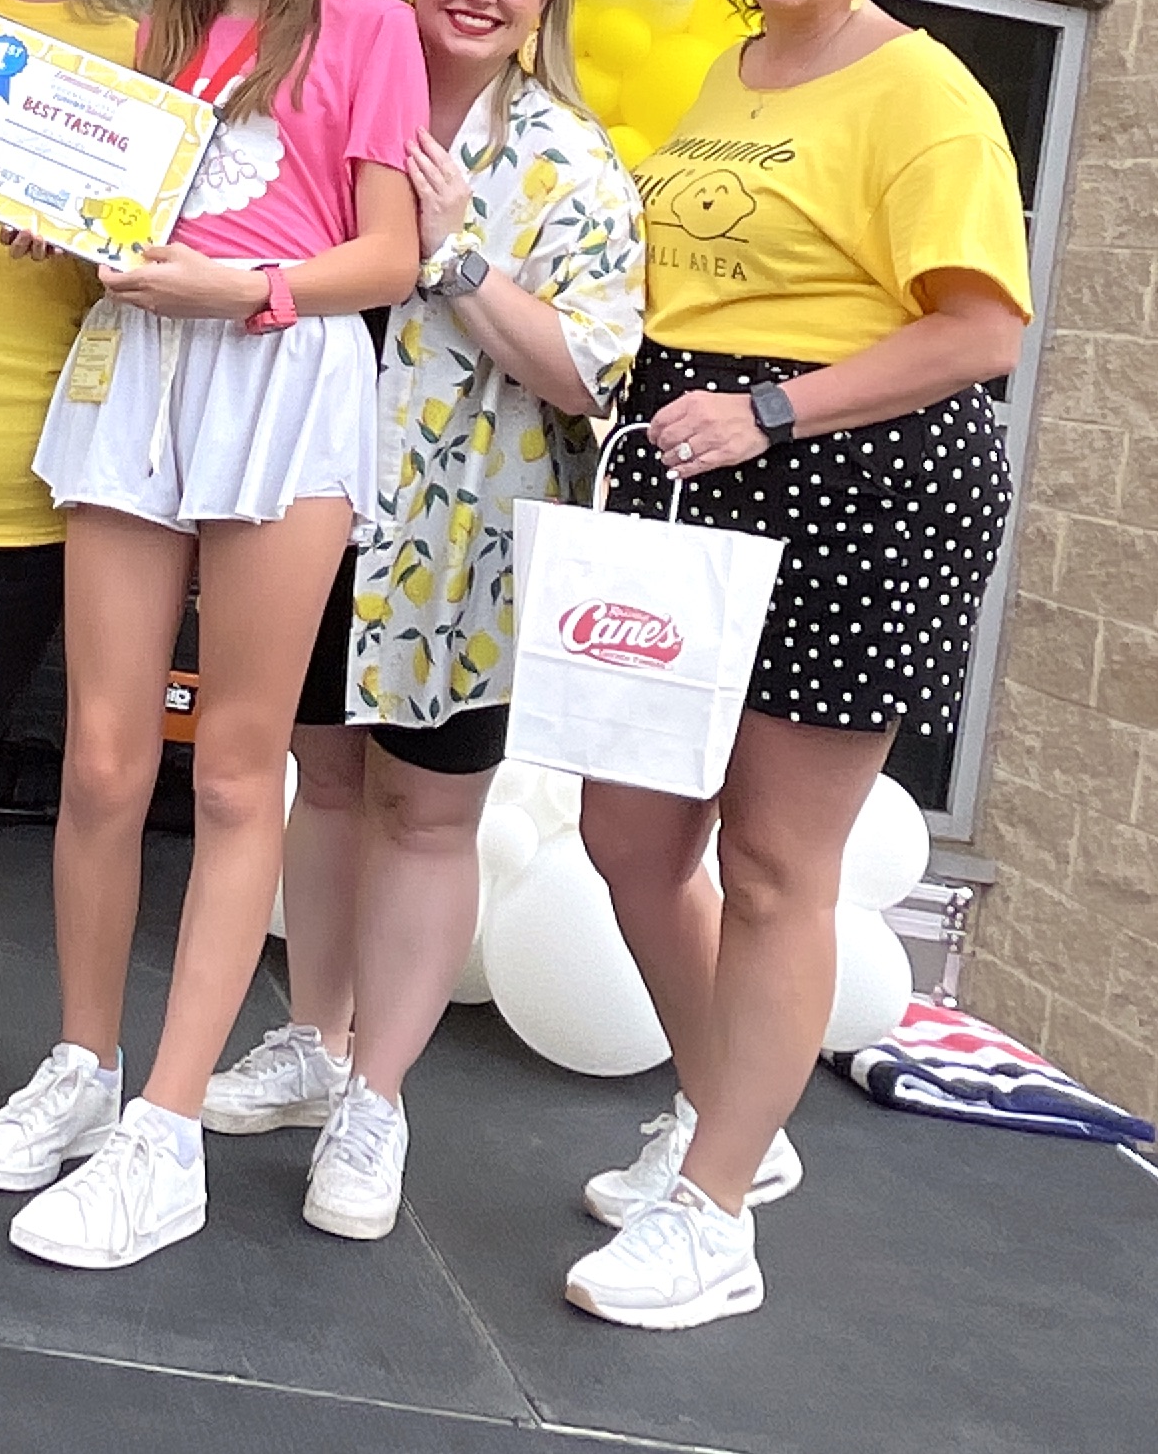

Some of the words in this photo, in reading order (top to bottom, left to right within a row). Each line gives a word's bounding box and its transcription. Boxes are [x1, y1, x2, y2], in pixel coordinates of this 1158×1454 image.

[22, 96, 63, 123] BEST
[64, 112, 130, 153] TASTING
[689, 252, 748, 282] AREA
[561, 597, 681, 652] Cane's
